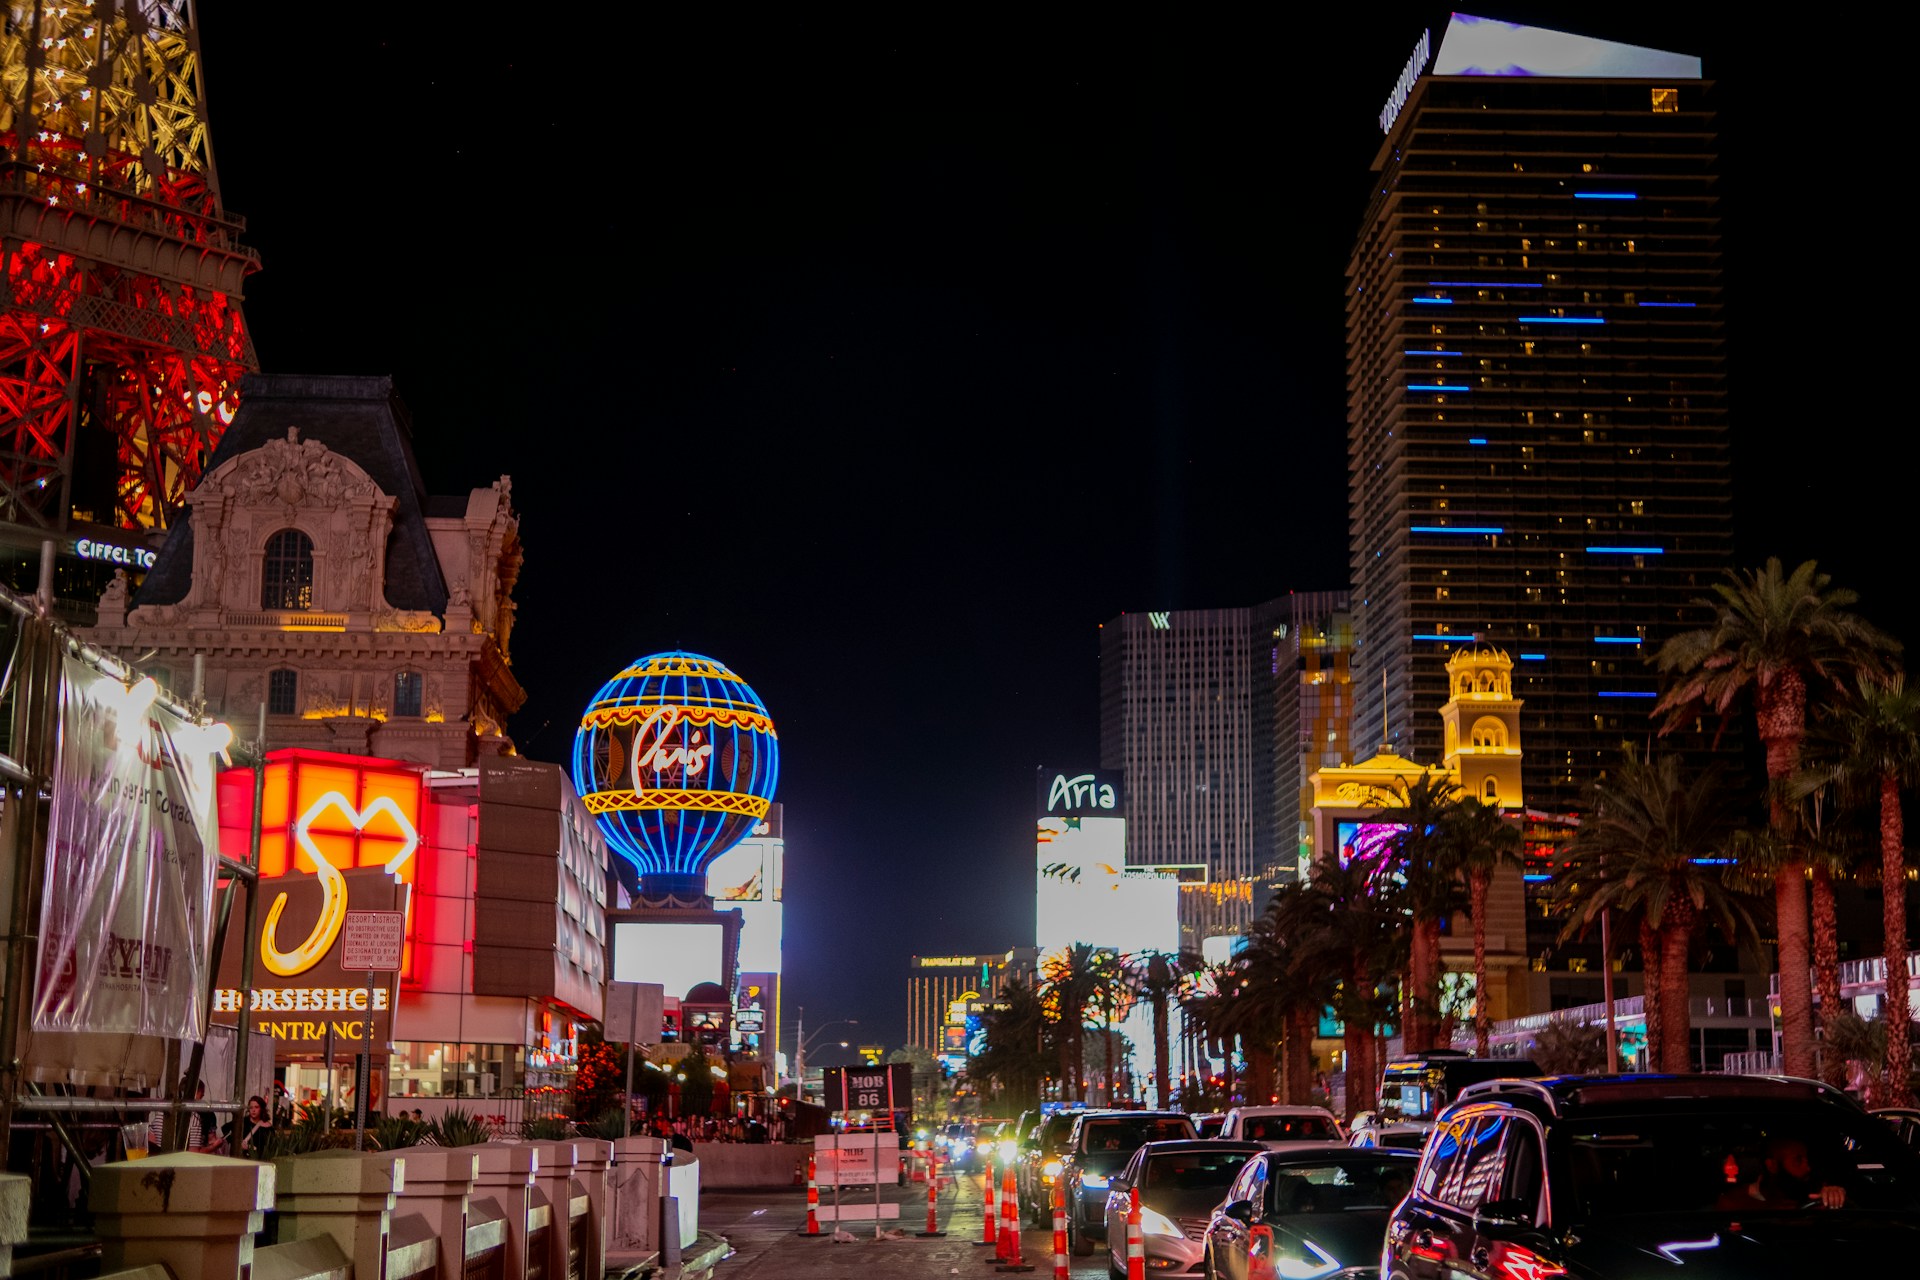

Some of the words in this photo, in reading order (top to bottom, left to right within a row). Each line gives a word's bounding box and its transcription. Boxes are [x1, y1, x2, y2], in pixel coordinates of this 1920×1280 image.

[77, 538, 131, 565] EIFFEL
[631, 704, 713, 798] Paris
[1047, 774, 1116, 812] Aria
[348, 915, 371, 923] RESORT
[373, 916, 399, 924] DISTRICT
[213, 988, 388, 1011] HORSESHOE
[851, 1075, 885, 1088] MOB
[858, 1093, 880, 1106] 86
